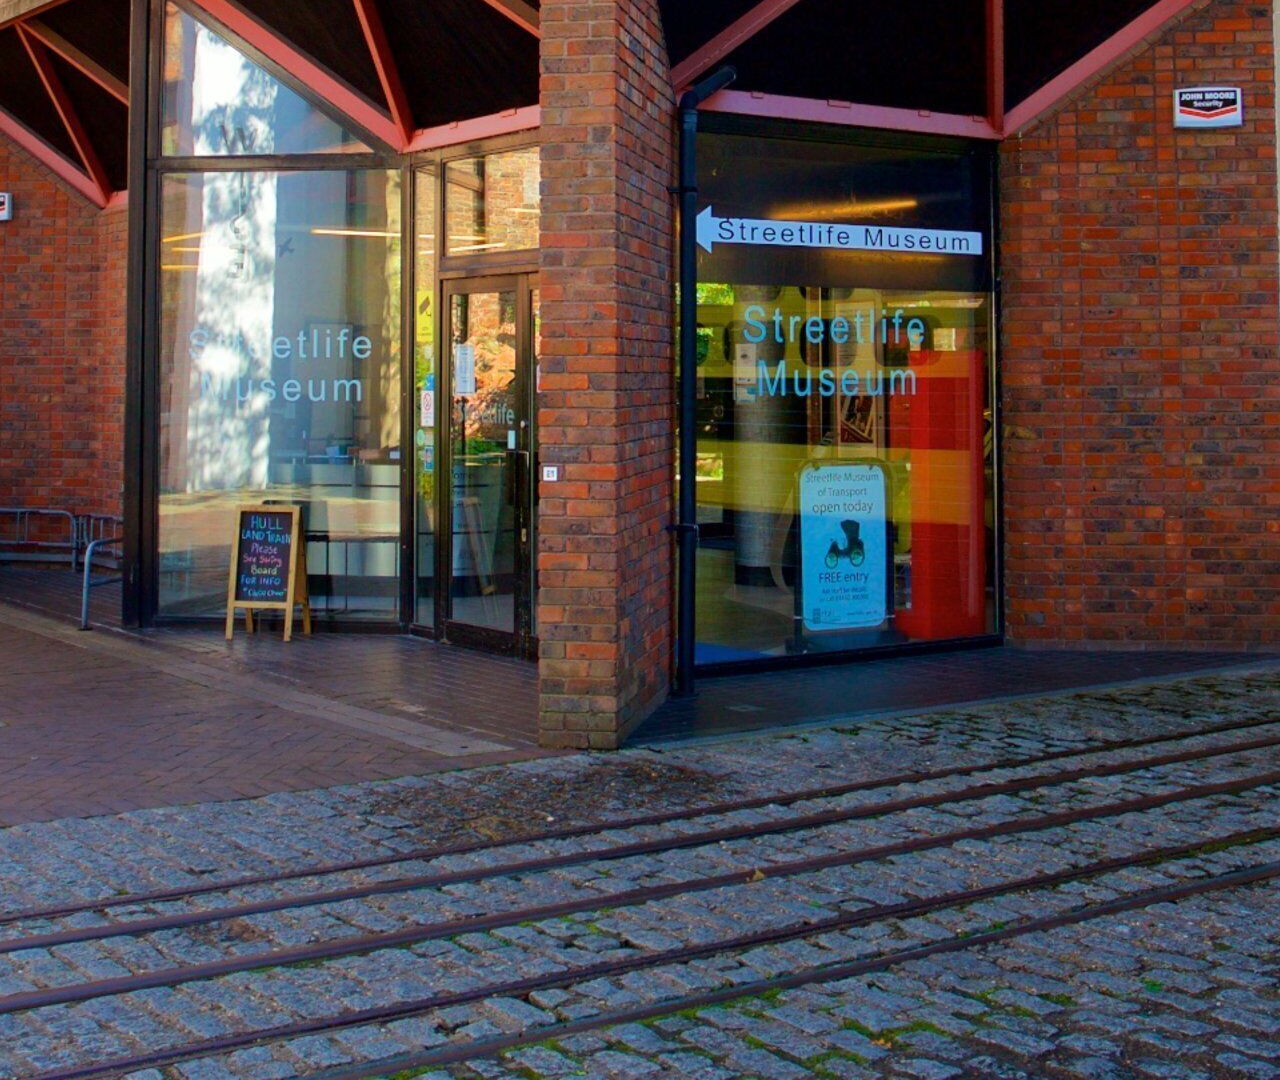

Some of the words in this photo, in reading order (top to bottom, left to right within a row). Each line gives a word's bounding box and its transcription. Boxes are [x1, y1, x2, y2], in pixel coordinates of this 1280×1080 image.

[1181, 92, 1203, 100] JOHN
[1204, 92, 1235, 100] MOORE
[1193, 100, 1223, 108] Security
[717, 219, 850, 246] Streetlife
[864, 227, 970, 252] Museum
[743, 304, 925, 345] Streetlife
[757, 359, 917, 397] Museum
[805, 472, 840, 483] Streetlife
[842, 471, 879, 481] Museum
[818, 487, 826, 497] of
[827, 487, 867, 499] Transport
[812, 503, 840, 516] open
[843, 500, 874, 514] today
[250, 515, 283, 530] HULL
[251, 542, 278, 554] Please
[251, 564, 278, 575] Board
[818, 571, 842, 584] FREE
[844, 572, 870, 584] entry
